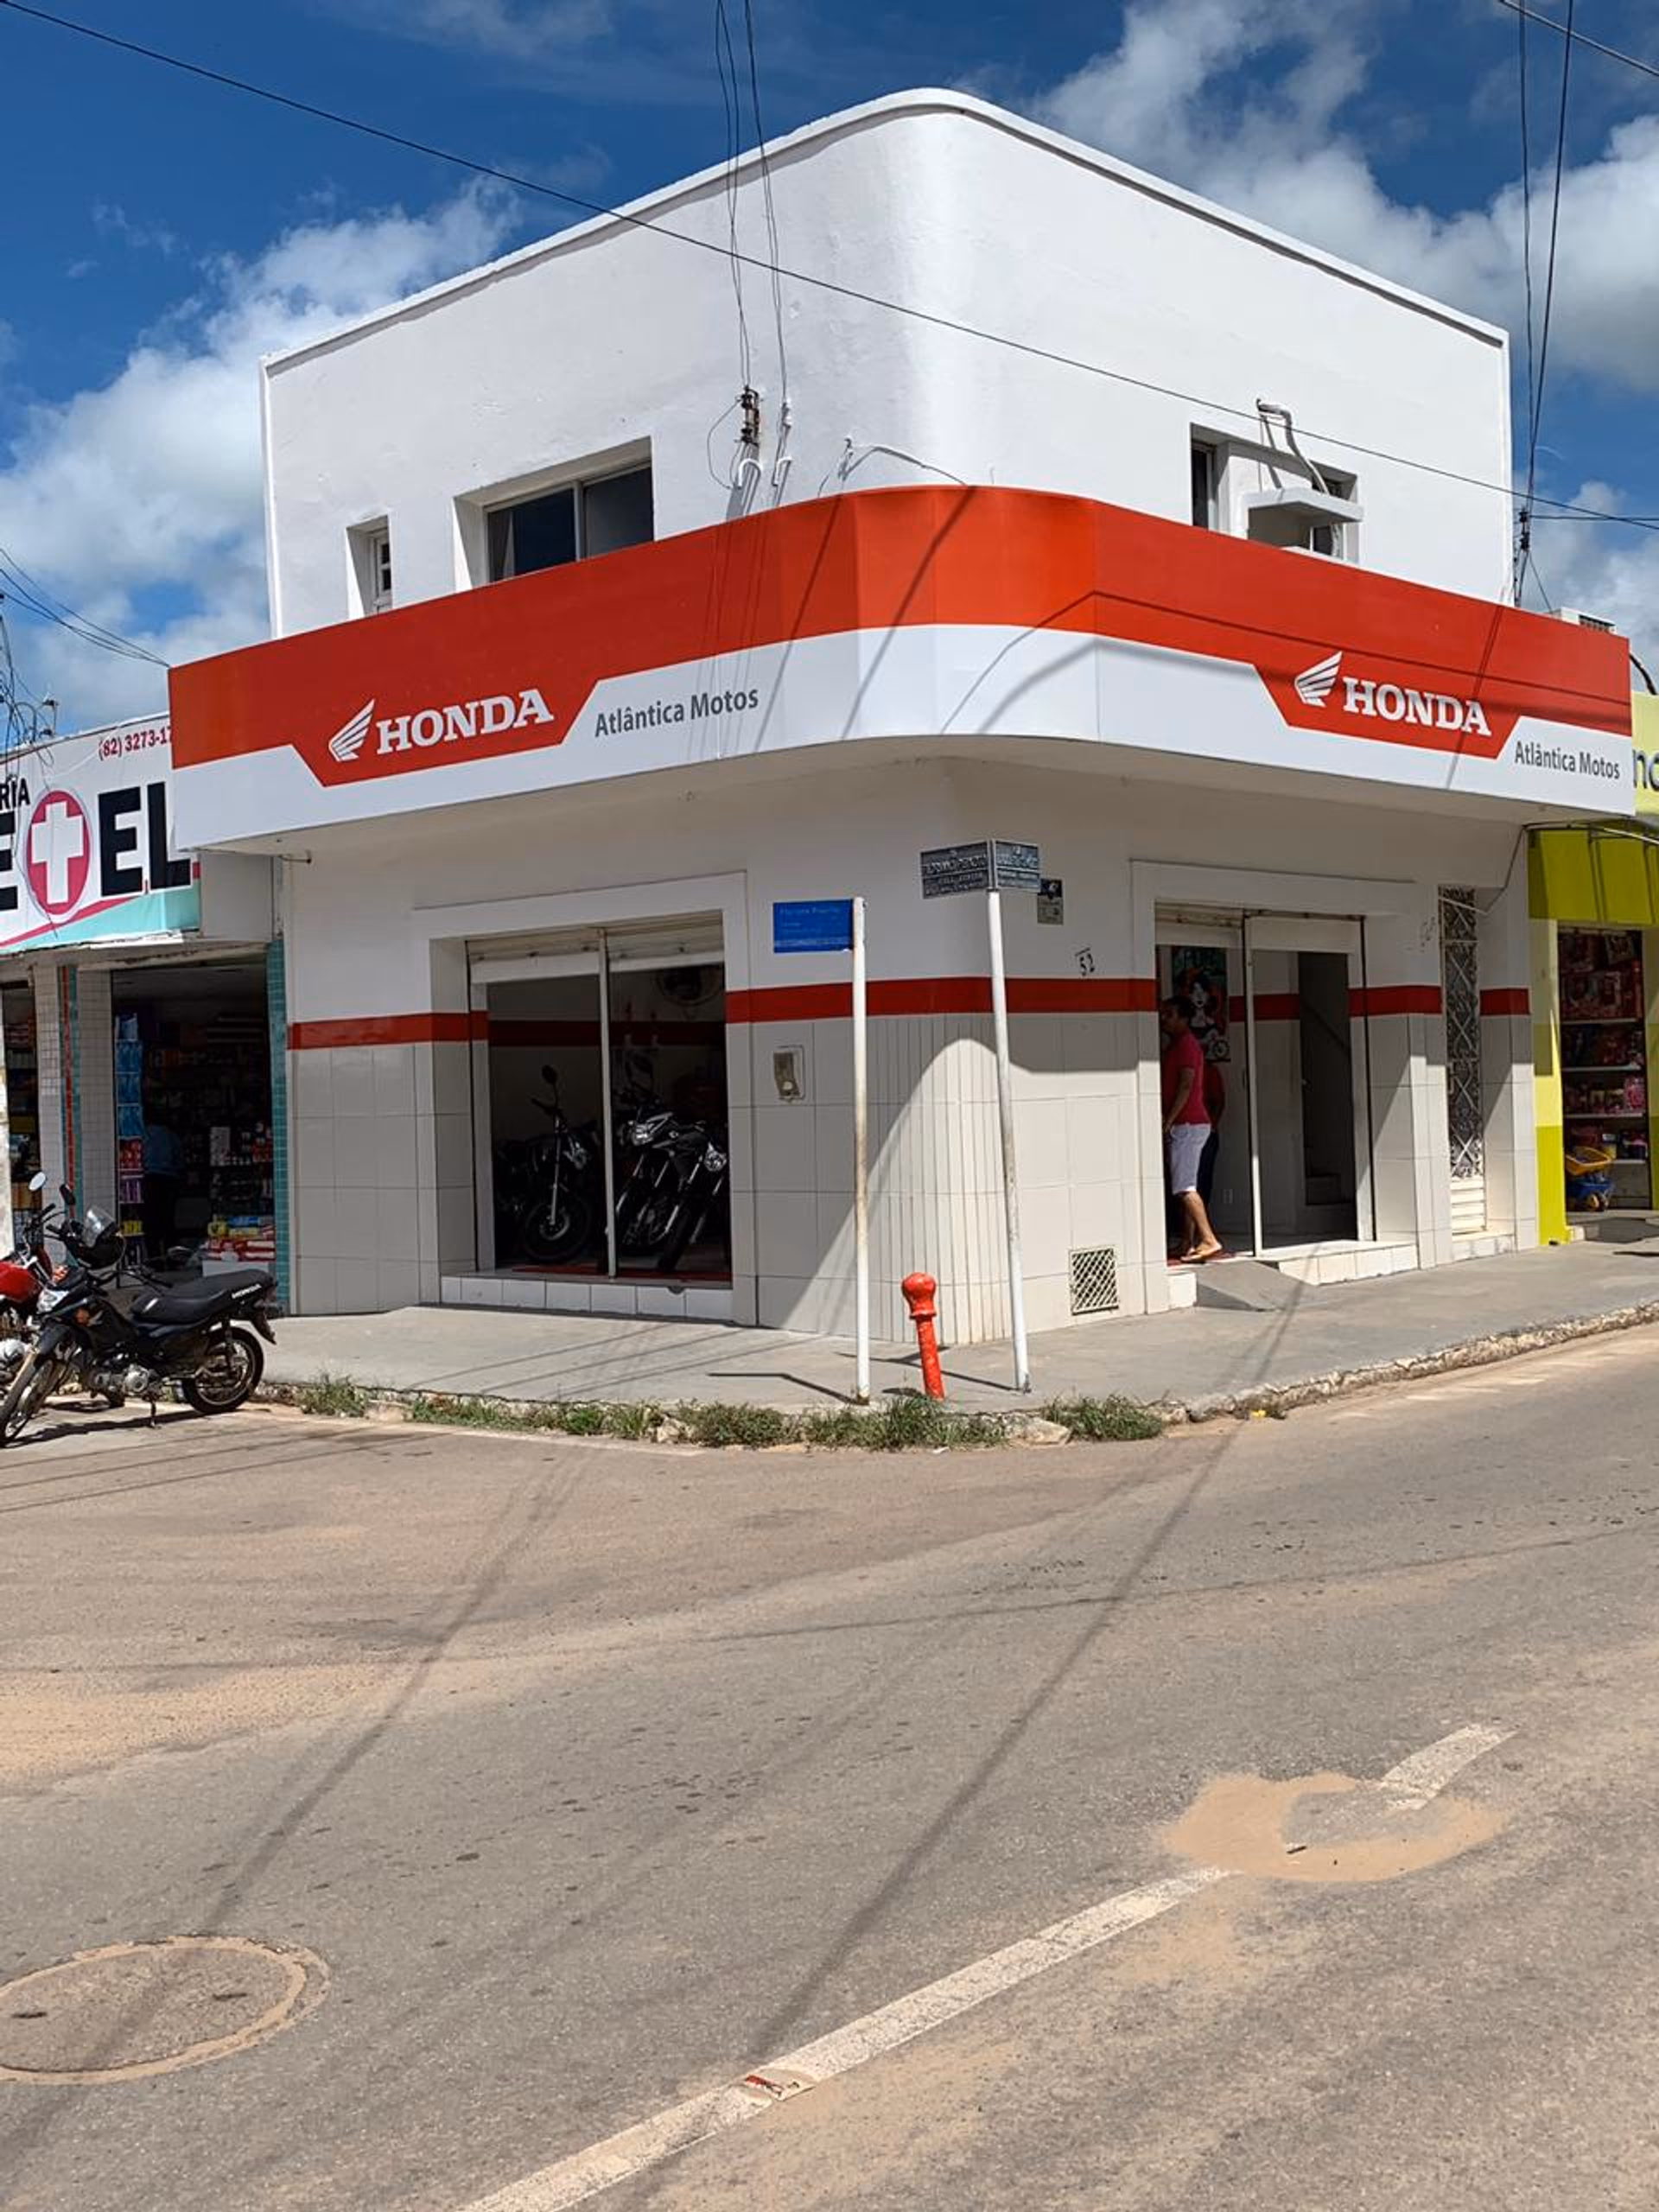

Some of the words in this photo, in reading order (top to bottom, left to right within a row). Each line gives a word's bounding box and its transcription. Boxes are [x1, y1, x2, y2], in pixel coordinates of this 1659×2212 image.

[377, 689, 554, 754] HONDA
[594, 699, 685, 738] Atlântica
[690, 685, 760, 721] Motos
[1342, 677, 1492, 737] HONDA
[98, 737, 123, 761] (82)
[1514, 740, 1576, 772] Atlântica
[1579, 751, 1621, 779] Motos
